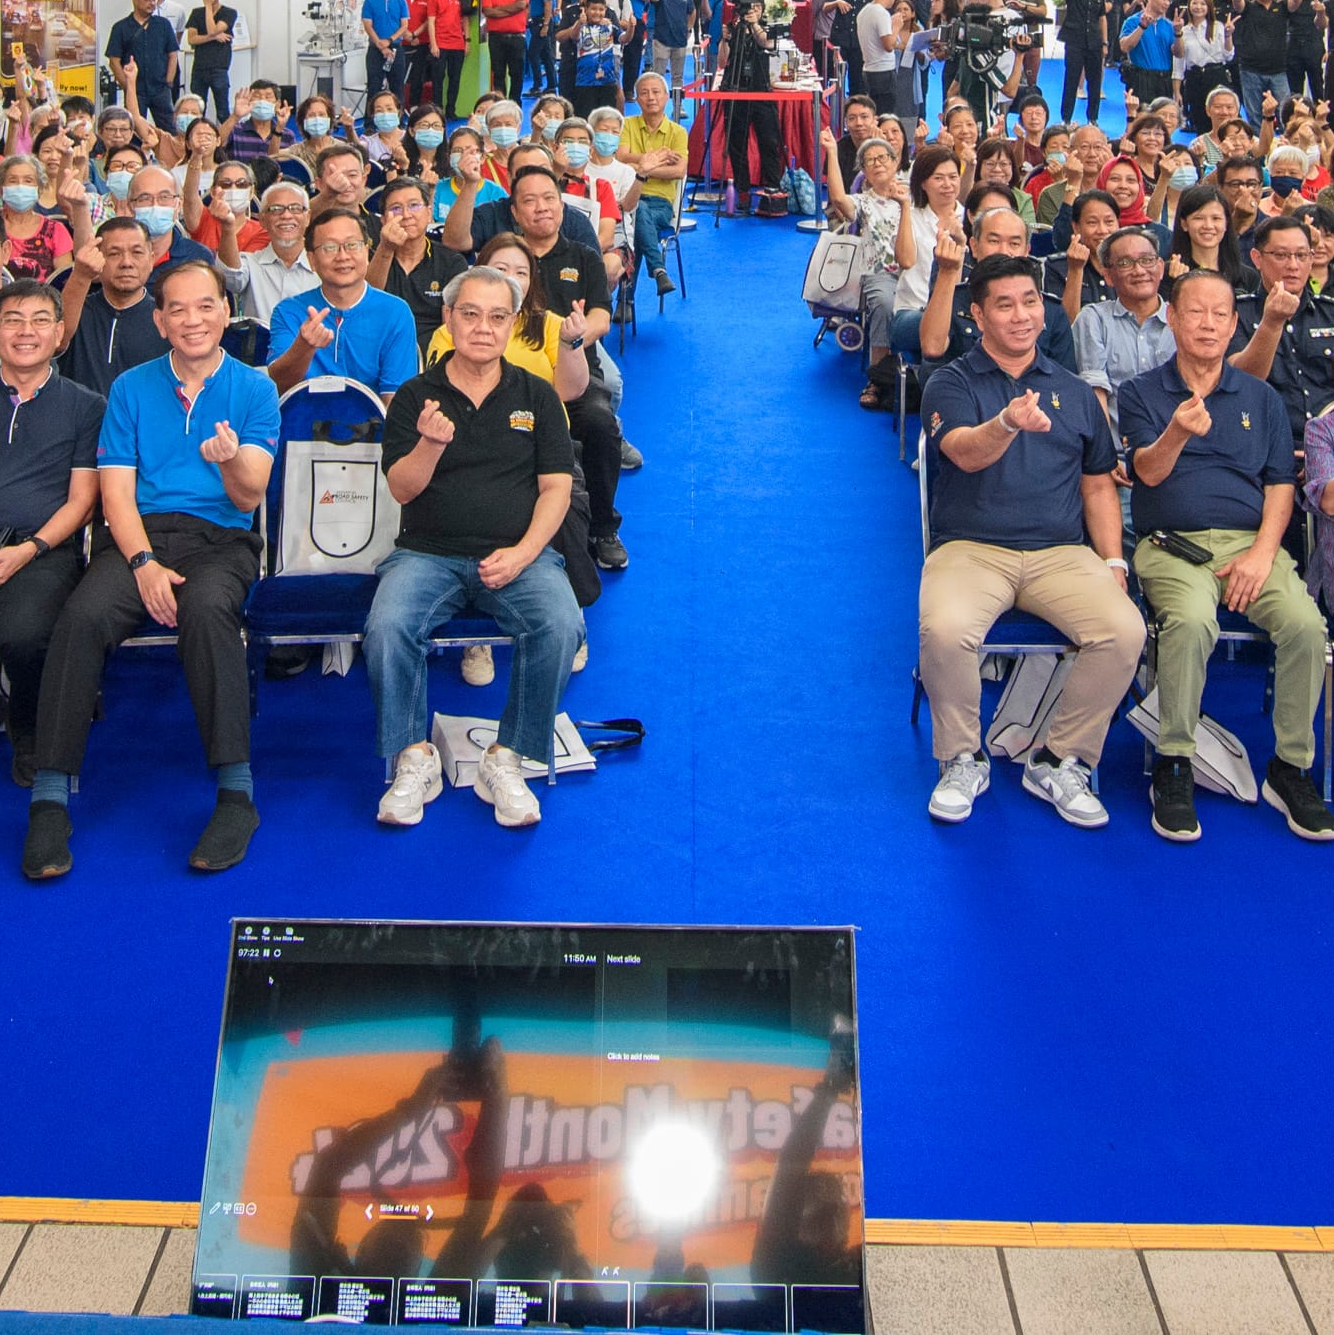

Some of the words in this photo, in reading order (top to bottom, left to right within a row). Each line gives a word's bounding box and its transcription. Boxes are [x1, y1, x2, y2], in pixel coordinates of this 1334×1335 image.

[70, 84, 88, 92] now!
[238, 948, 260, 958] 97:22
[564, 953, 585, 963] 11:50
[607, 954, 624, 963] Next
[625, 954, 641, 963] slide
[607, 1052, 622, 1061] Click
[623, 1052, 629, 1061] to
[631, 1052, 642, 1061] add
[643, 1053, 660, 1061] notes
[380, 1204, 394, 1213] Slide
[395, 1205, 403, 1213] 47
[404, 1205, 410, 1213] of
